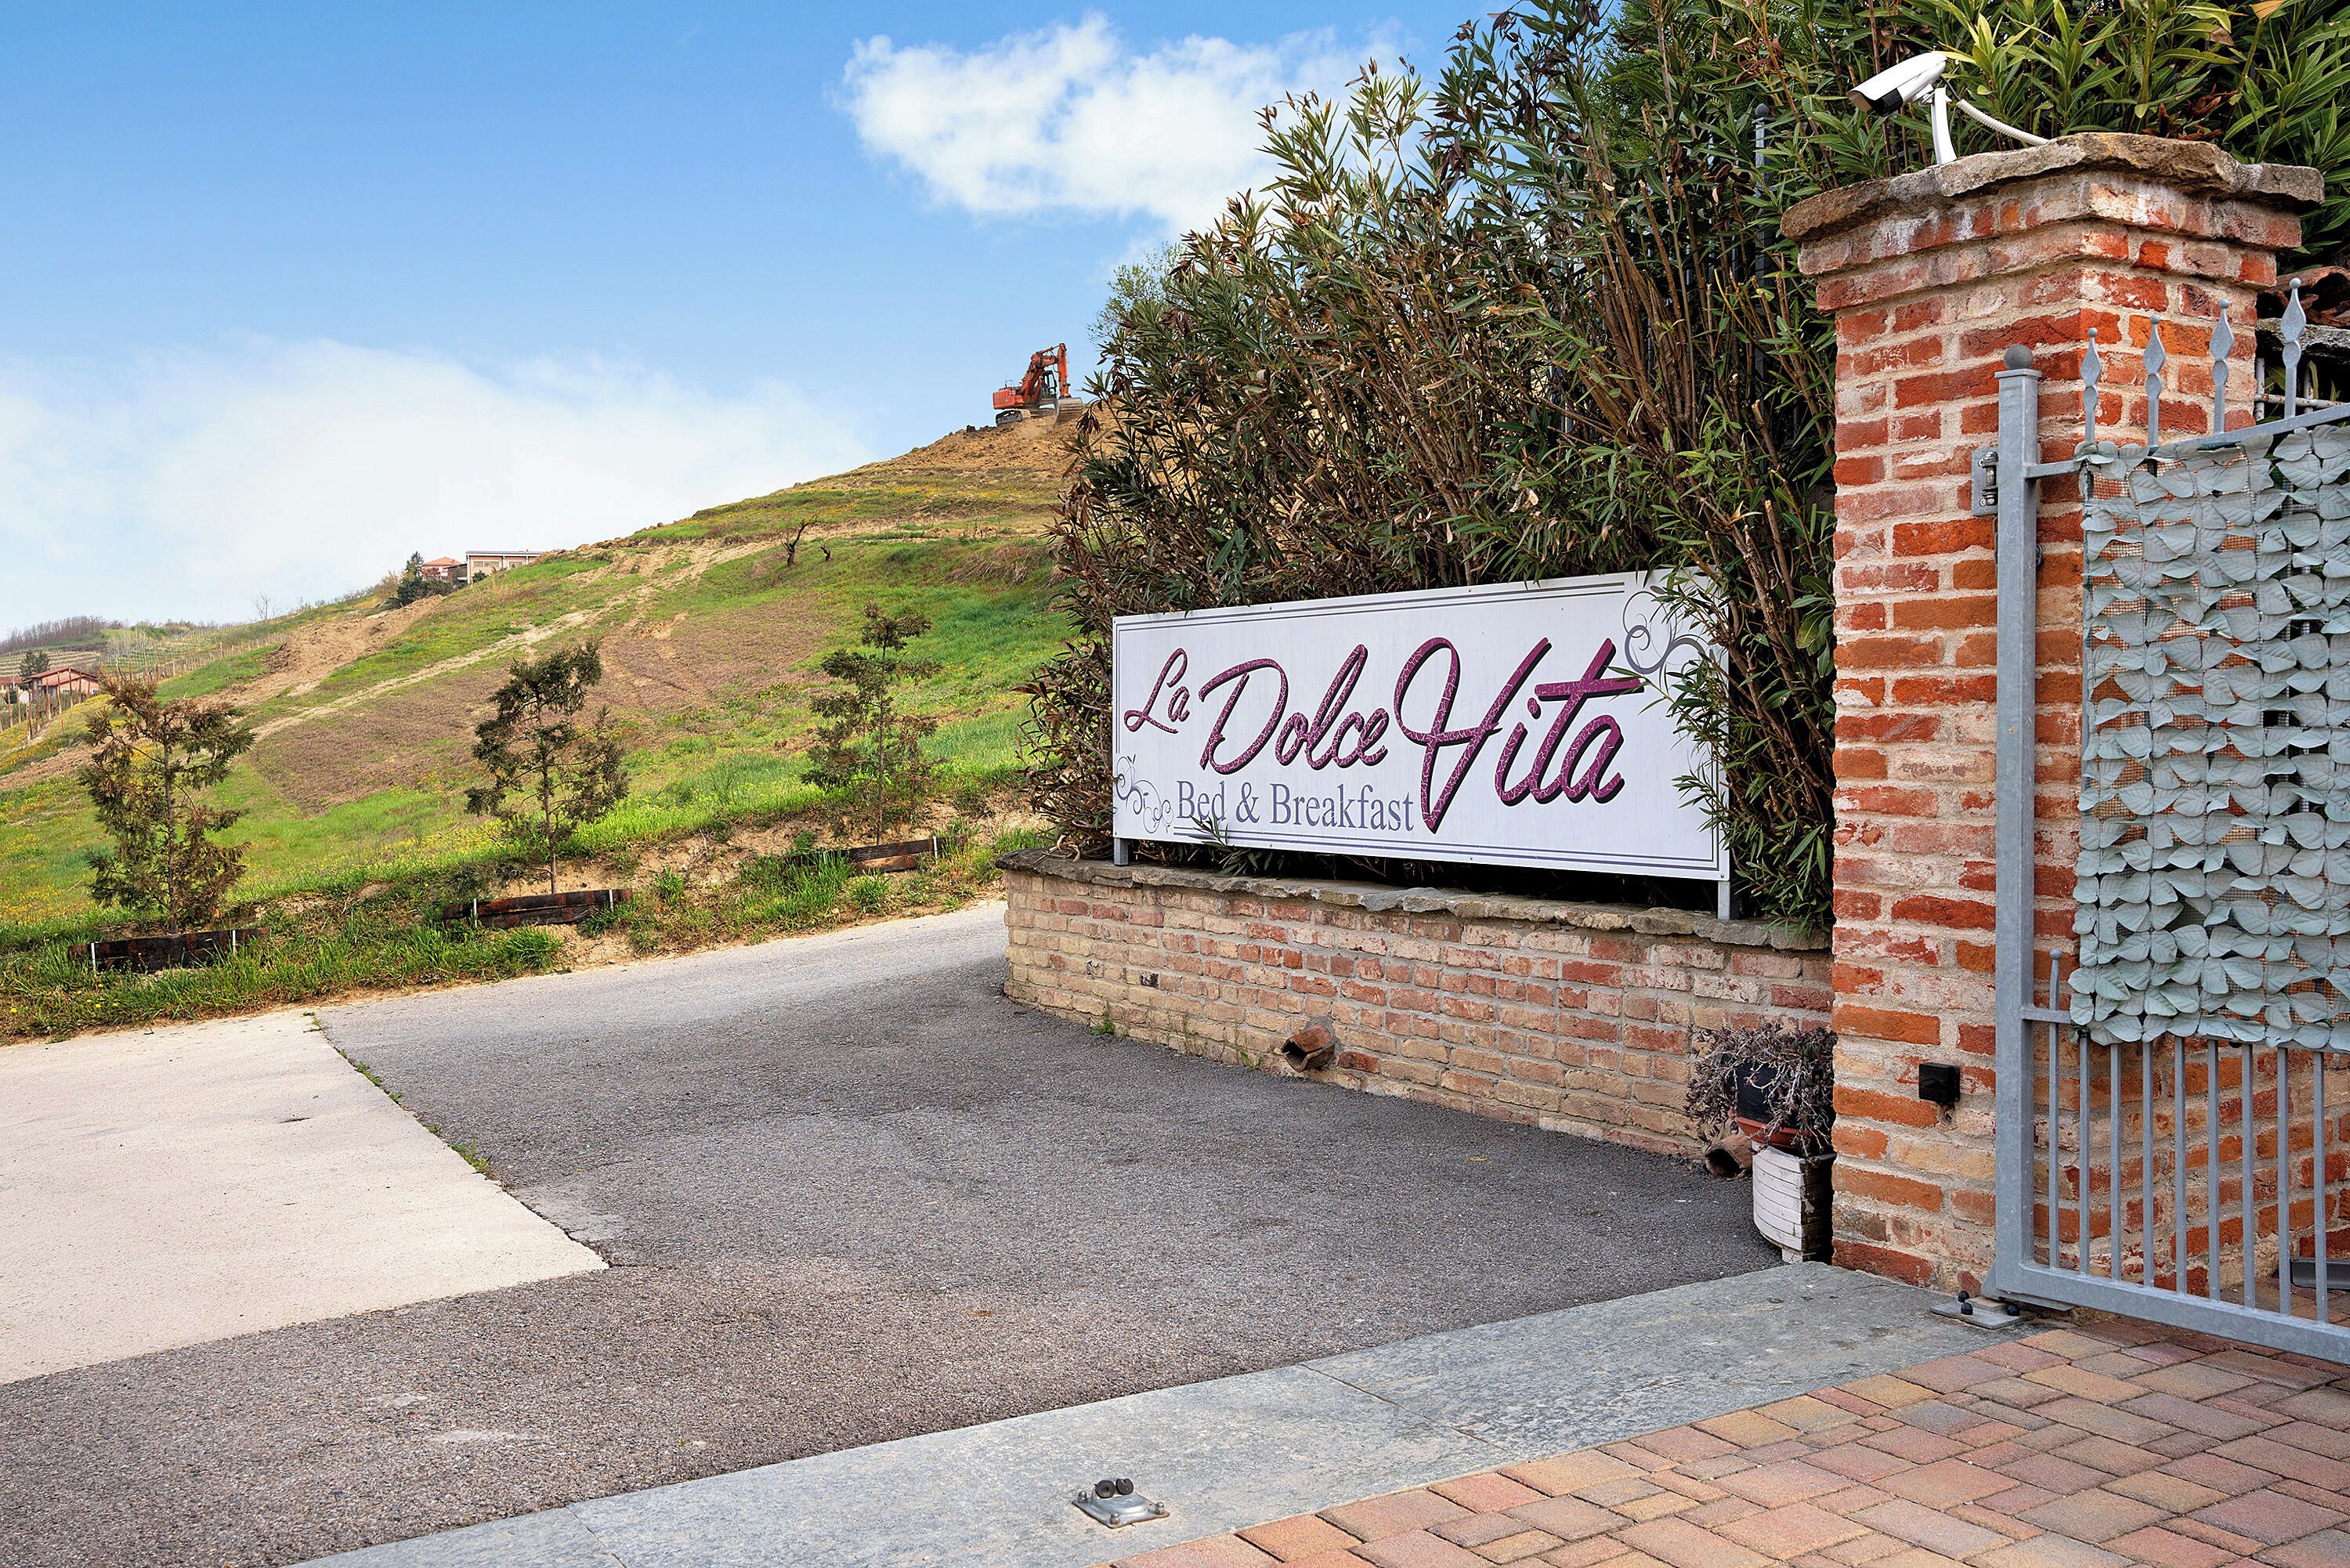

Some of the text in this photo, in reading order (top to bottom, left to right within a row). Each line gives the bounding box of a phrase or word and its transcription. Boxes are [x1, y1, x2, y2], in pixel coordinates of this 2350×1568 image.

[1123, 636, 1644, 835] La Dolce Vita
[1177, 779, 1415, 832] Bed & Breakfast
